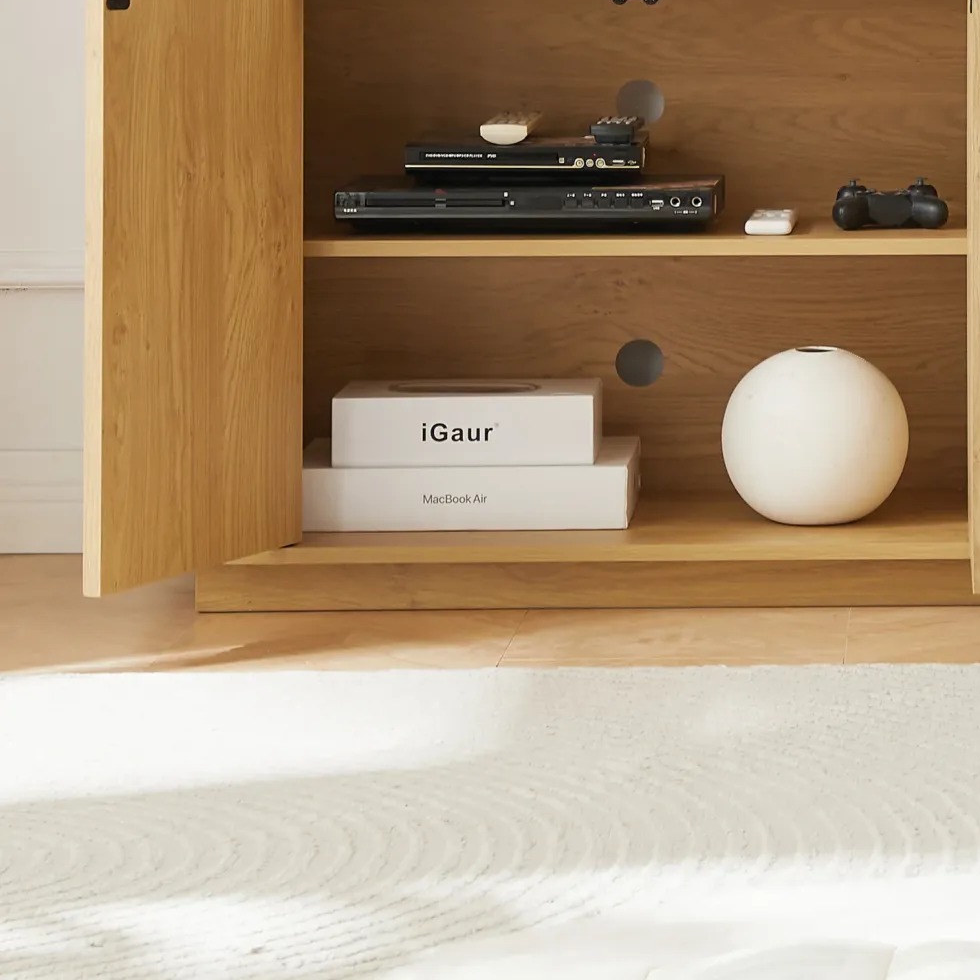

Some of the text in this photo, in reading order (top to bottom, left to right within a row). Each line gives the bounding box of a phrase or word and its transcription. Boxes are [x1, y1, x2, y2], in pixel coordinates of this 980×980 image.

[421, 422, 493, 443] iGaur
[422, 494, 488, 504] MacBook Air
